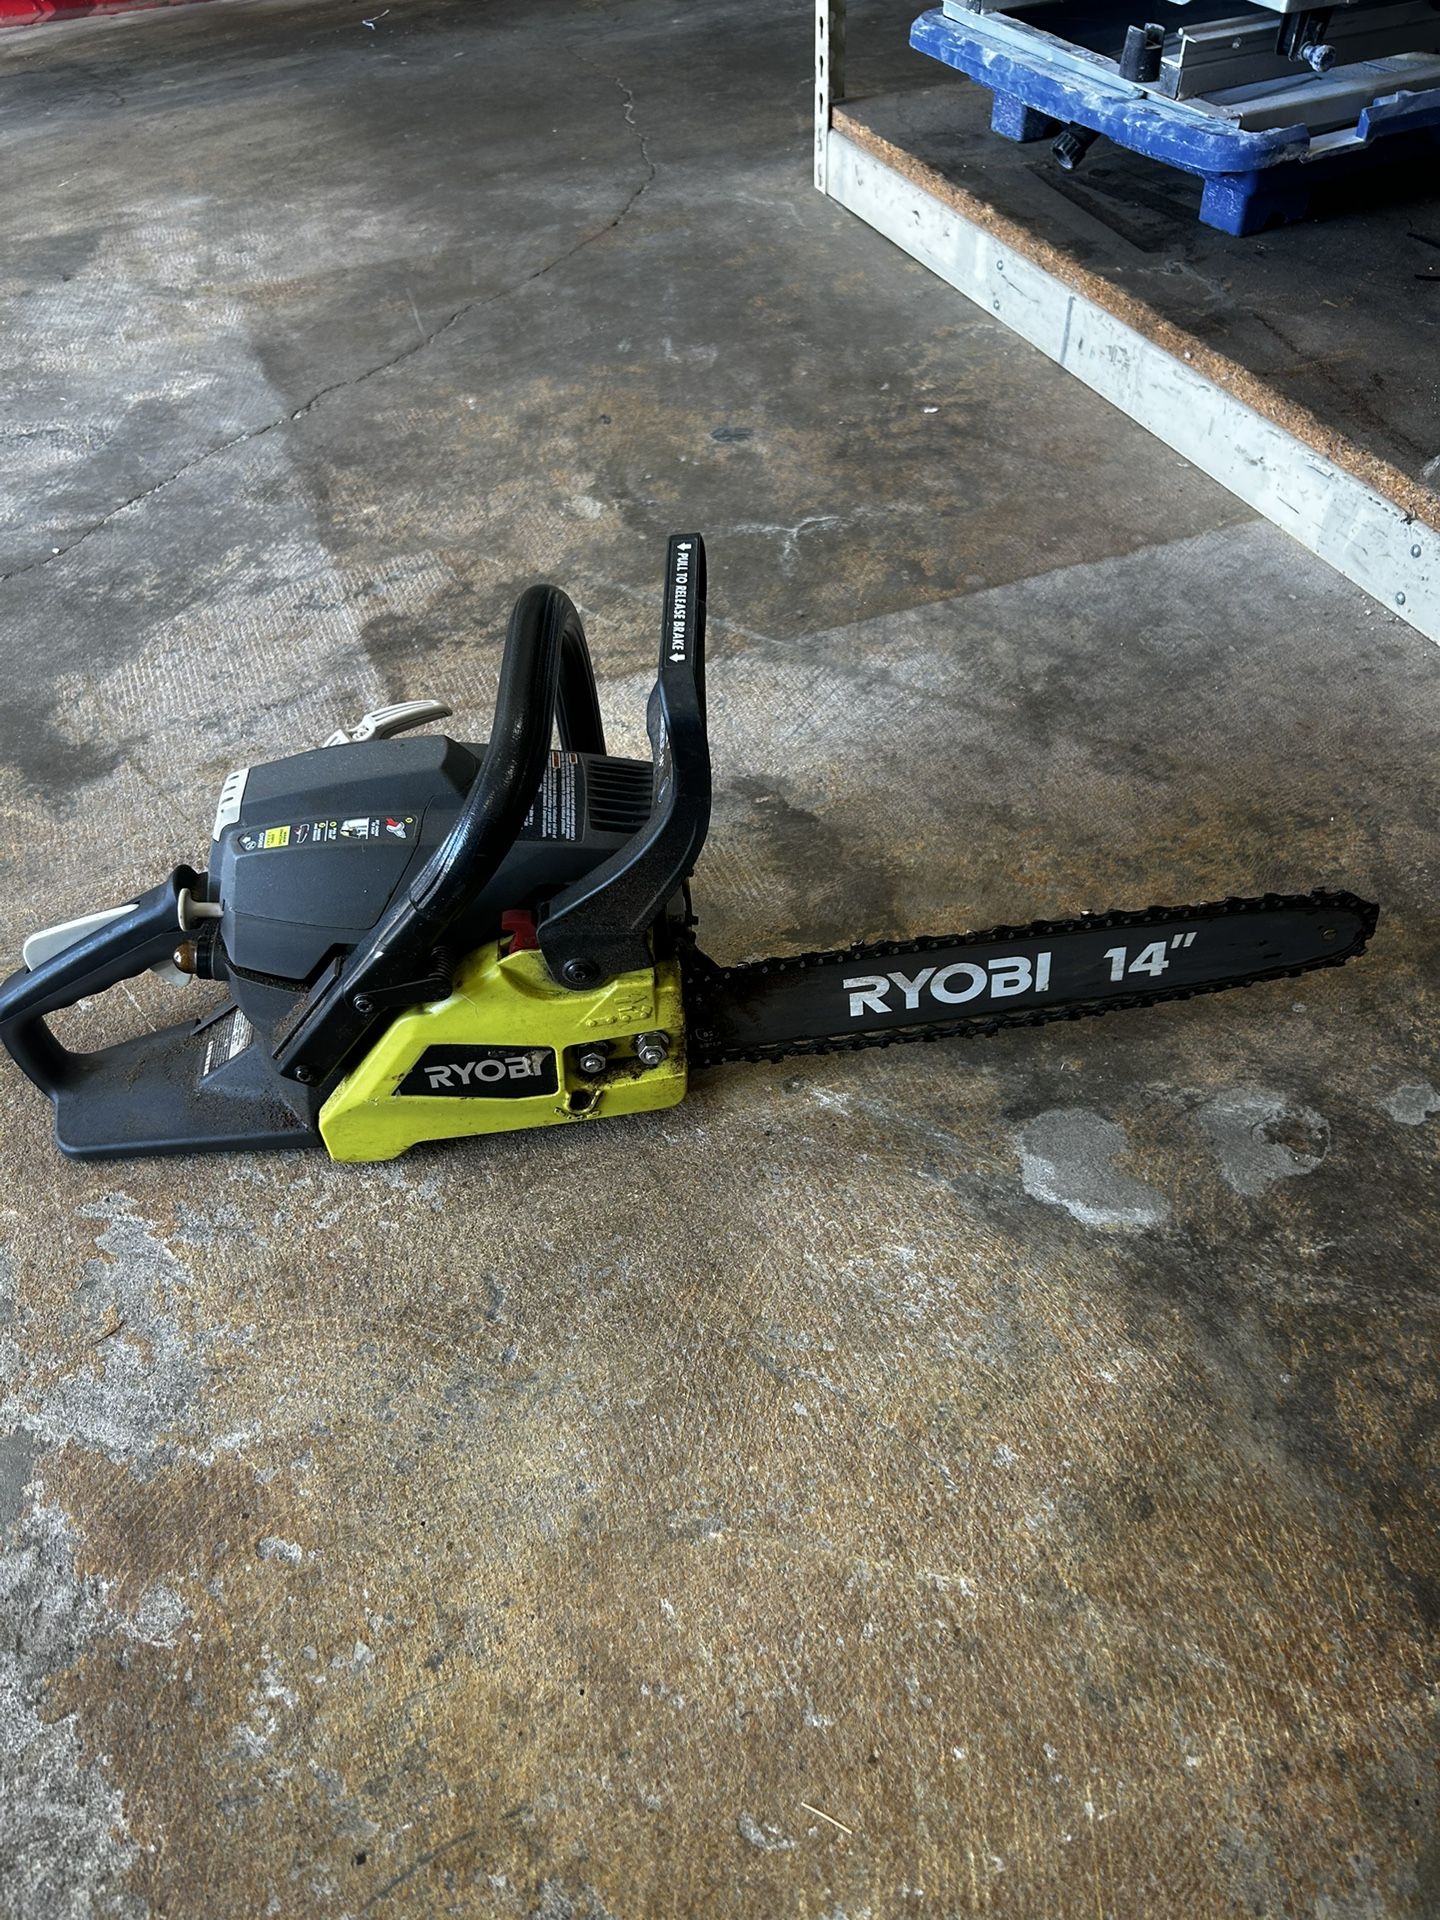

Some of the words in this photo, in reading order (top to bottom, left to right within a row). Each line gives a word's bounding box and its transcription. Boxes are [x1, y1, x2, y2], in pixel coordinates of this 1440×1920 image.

[677, 552, 689, 572] PULL
[675, 573, 688, 583] TO
[674, 585, 687, 619] RELEASE
[672, 621, 685, 650] BRAKE
[842, 951, 1052, 1017] RYOBI
